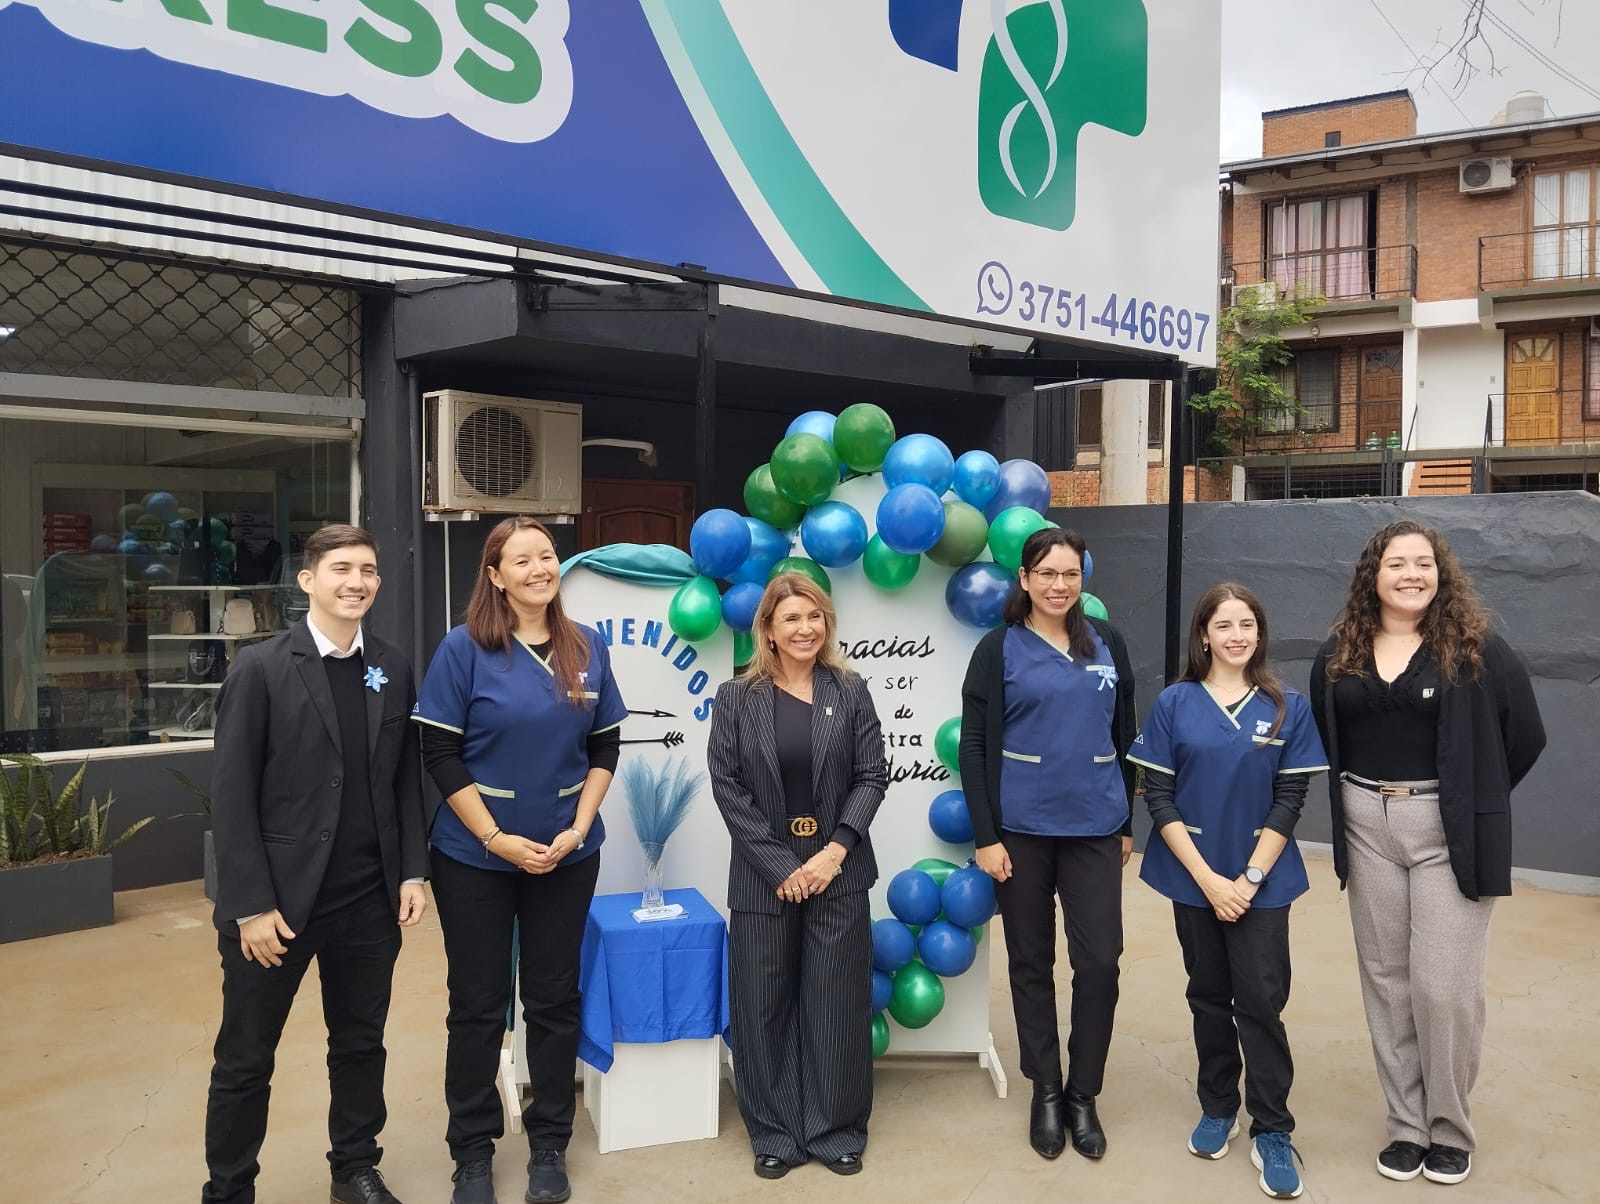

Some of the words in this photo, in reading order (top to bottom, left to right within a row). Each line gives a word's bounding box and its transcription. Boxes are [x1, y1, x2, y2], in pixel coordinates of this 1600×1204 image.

[1018, 281, 1210, 353] 3751-446697
[839, 635, 935, 660] racias
[596, 618, 716, 721] VENIDOS
[884, 675, 919, 690] ser
[894, 703, 914, 719] de
